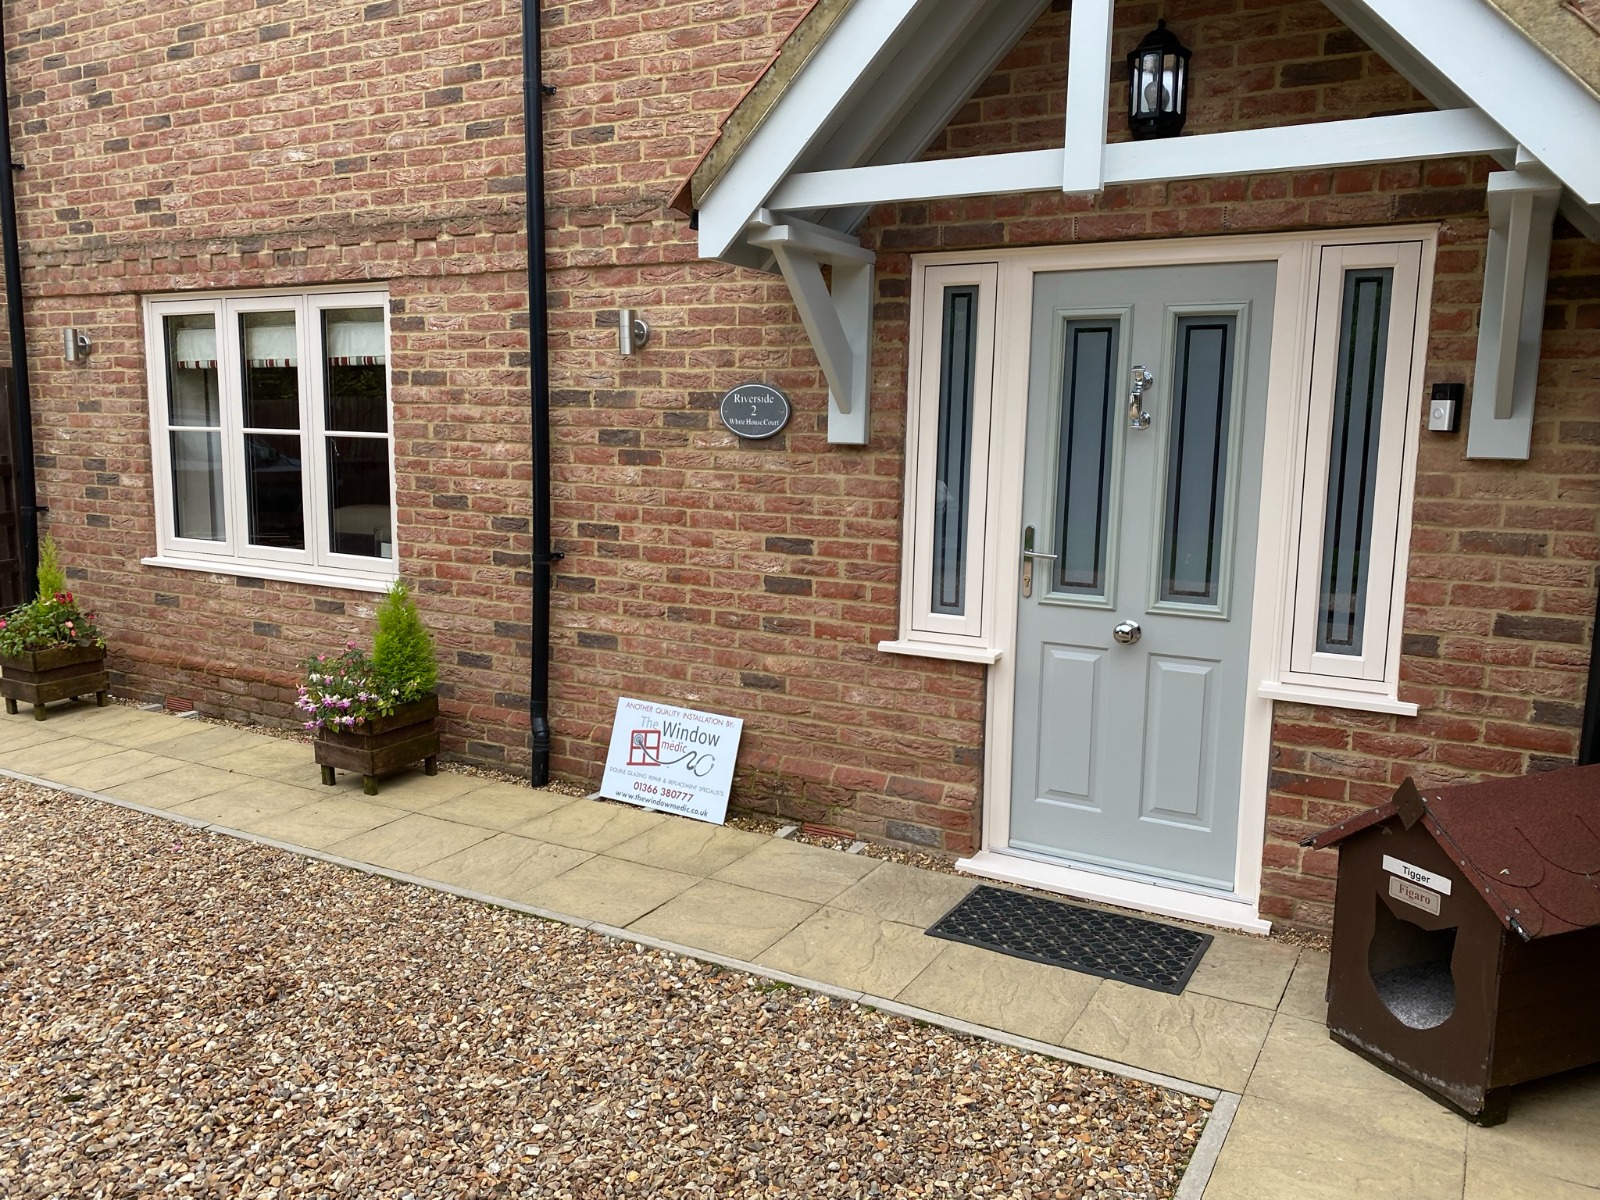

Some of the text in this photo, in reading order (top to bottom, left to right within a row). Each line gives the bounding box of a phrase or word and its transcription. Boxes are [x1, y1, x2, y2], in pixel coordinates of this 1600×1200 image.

[734, 393, 774, 403] Riverside
[751, 405, 757, 416] 2
[626, 702, 653, 712] ANOTHER
[656, 707, 680, 717] QUALITY
[683, 712, 723, 725] INSTALLATION
[641, 716, 720, 747] The Window
[661, 741, 687, 753] medic
[627, 770, 647, 779] GLAZING
[668, 779, 697, 790] REPLACEMENT
[633, 781, 694, 802] 01366 380777
[615, 790, 708, 817] www.thewindowmedic.co.uk
[1402, 865, 1431, 883] Tigger
[1399, 883, 1430, 905] Figaro
